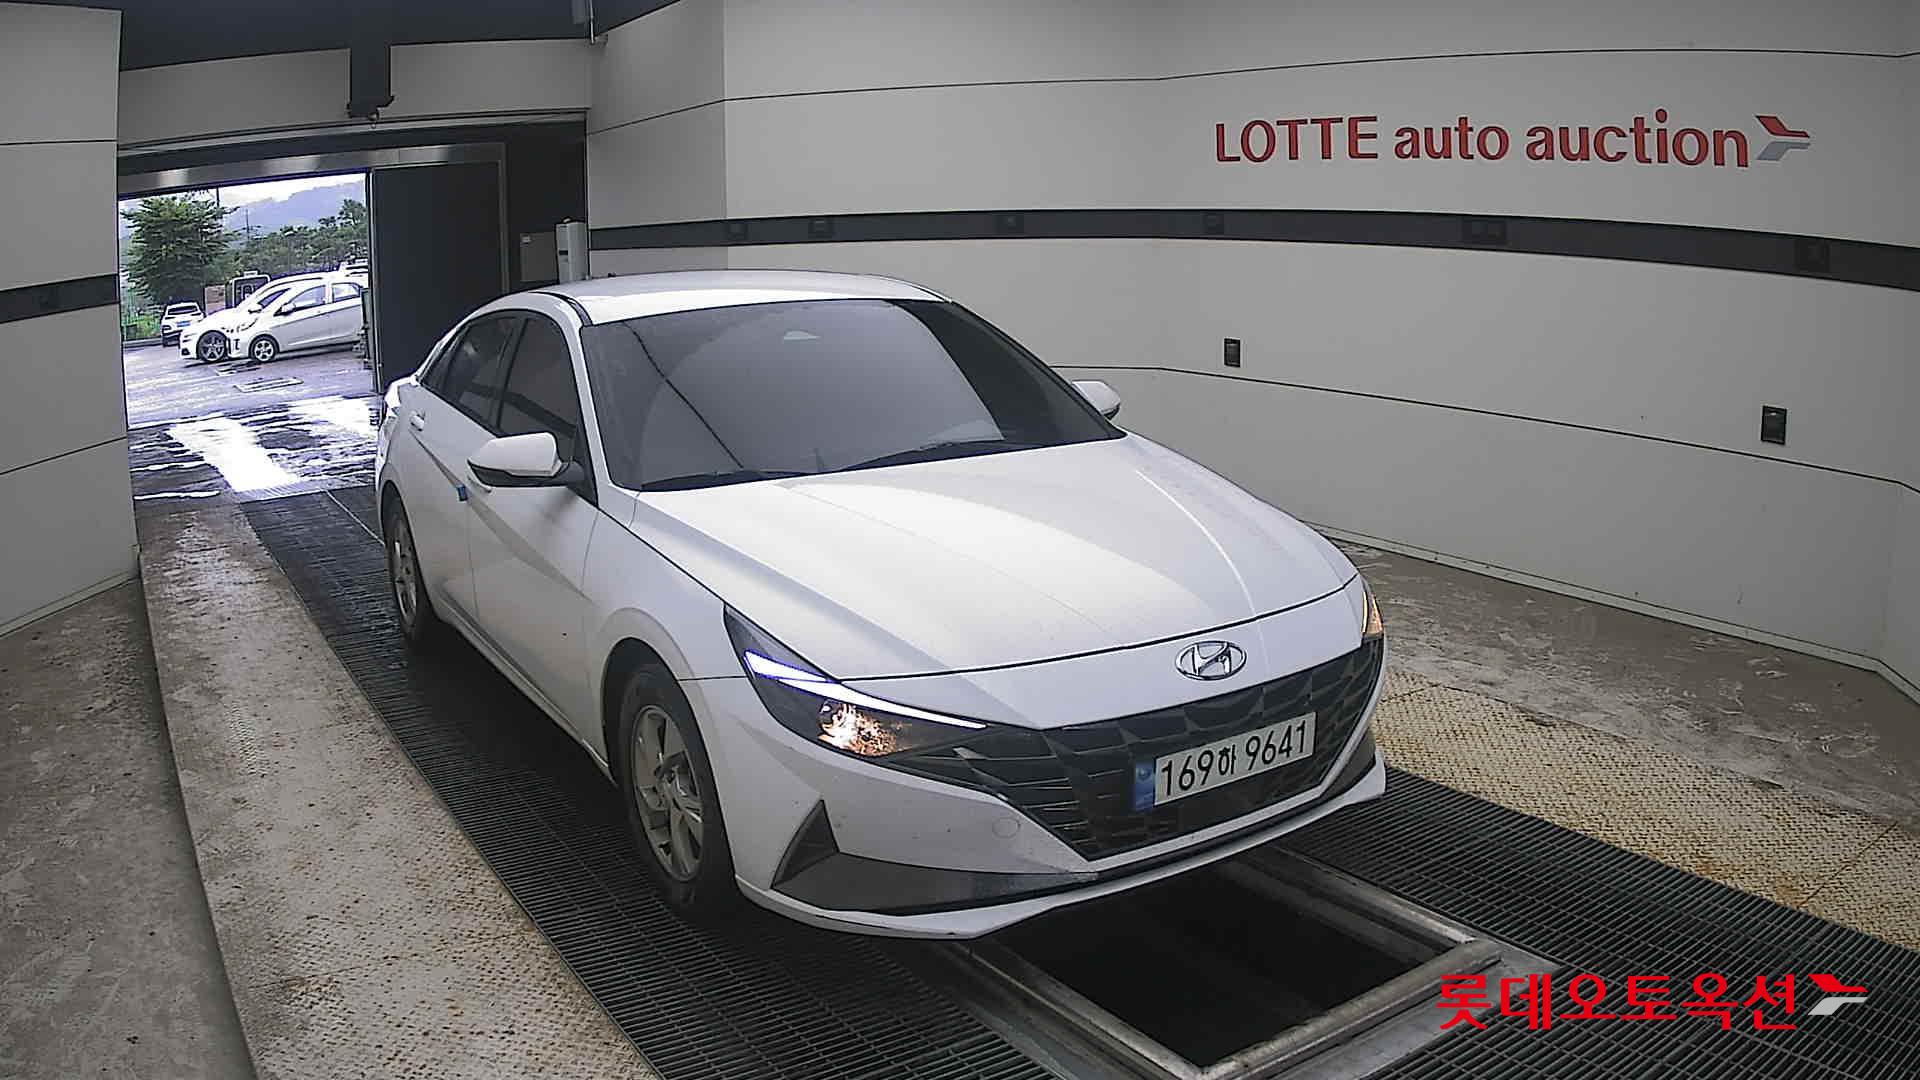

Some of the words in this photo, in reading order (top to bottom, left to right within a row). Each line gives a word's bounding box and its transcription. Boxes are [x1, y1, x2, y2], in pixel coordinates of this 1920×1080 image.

[1215, 115, 1379, 162] LOTTE
[1393, 117, 1510, 161] auto
[1525, 109, 1749, 168] auction
[1161, 744, 1237, 796] 169하
[1244, 719, 1306, 771] 9641
